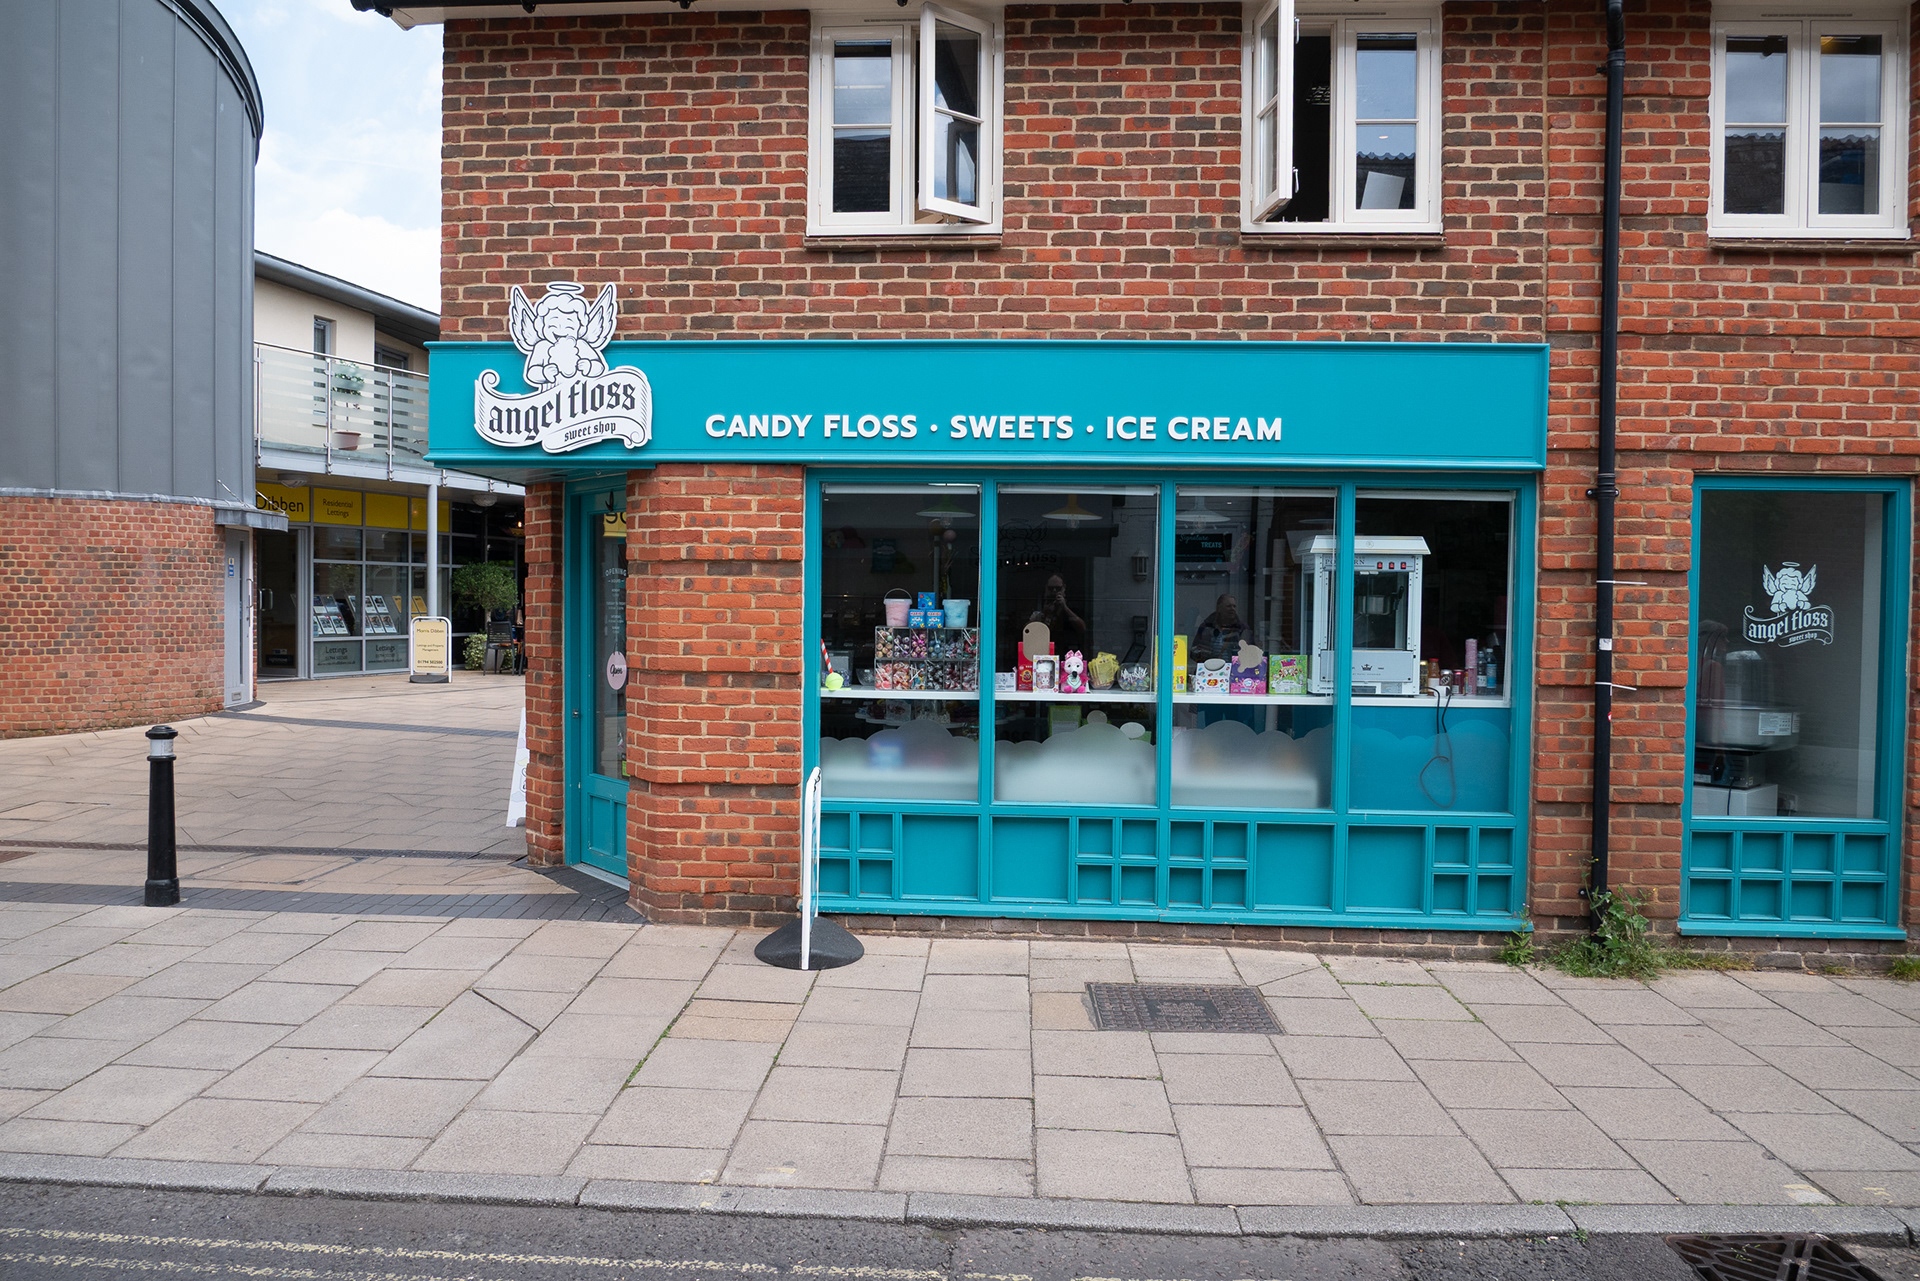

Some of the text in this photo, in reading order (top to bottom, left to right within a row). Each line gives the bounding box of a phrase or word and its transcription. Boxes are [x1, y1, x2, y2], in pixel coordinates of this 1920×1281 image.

[489, 380, 636, 441] angel floss
[564, 421, 617, 442] sweet shop
[705, 414, 1282, 441] CANDY FLOSS SWEETS ICE CREAM
[255, 494, 304, 513] Dibben
[322, 498, 354, 508] Residential
[327, 508, 350, 518] Lettings
[1201, 541, 1222, 549] TREATS
[605, 567, 627, 577] OPENING
[1748, 610, 1829, 642] angel floss
[1788, 632, 1818, 643] sweet shop
[325, 646, 348, 654] Lettings
[376, 644, 396, 652] Lettings
